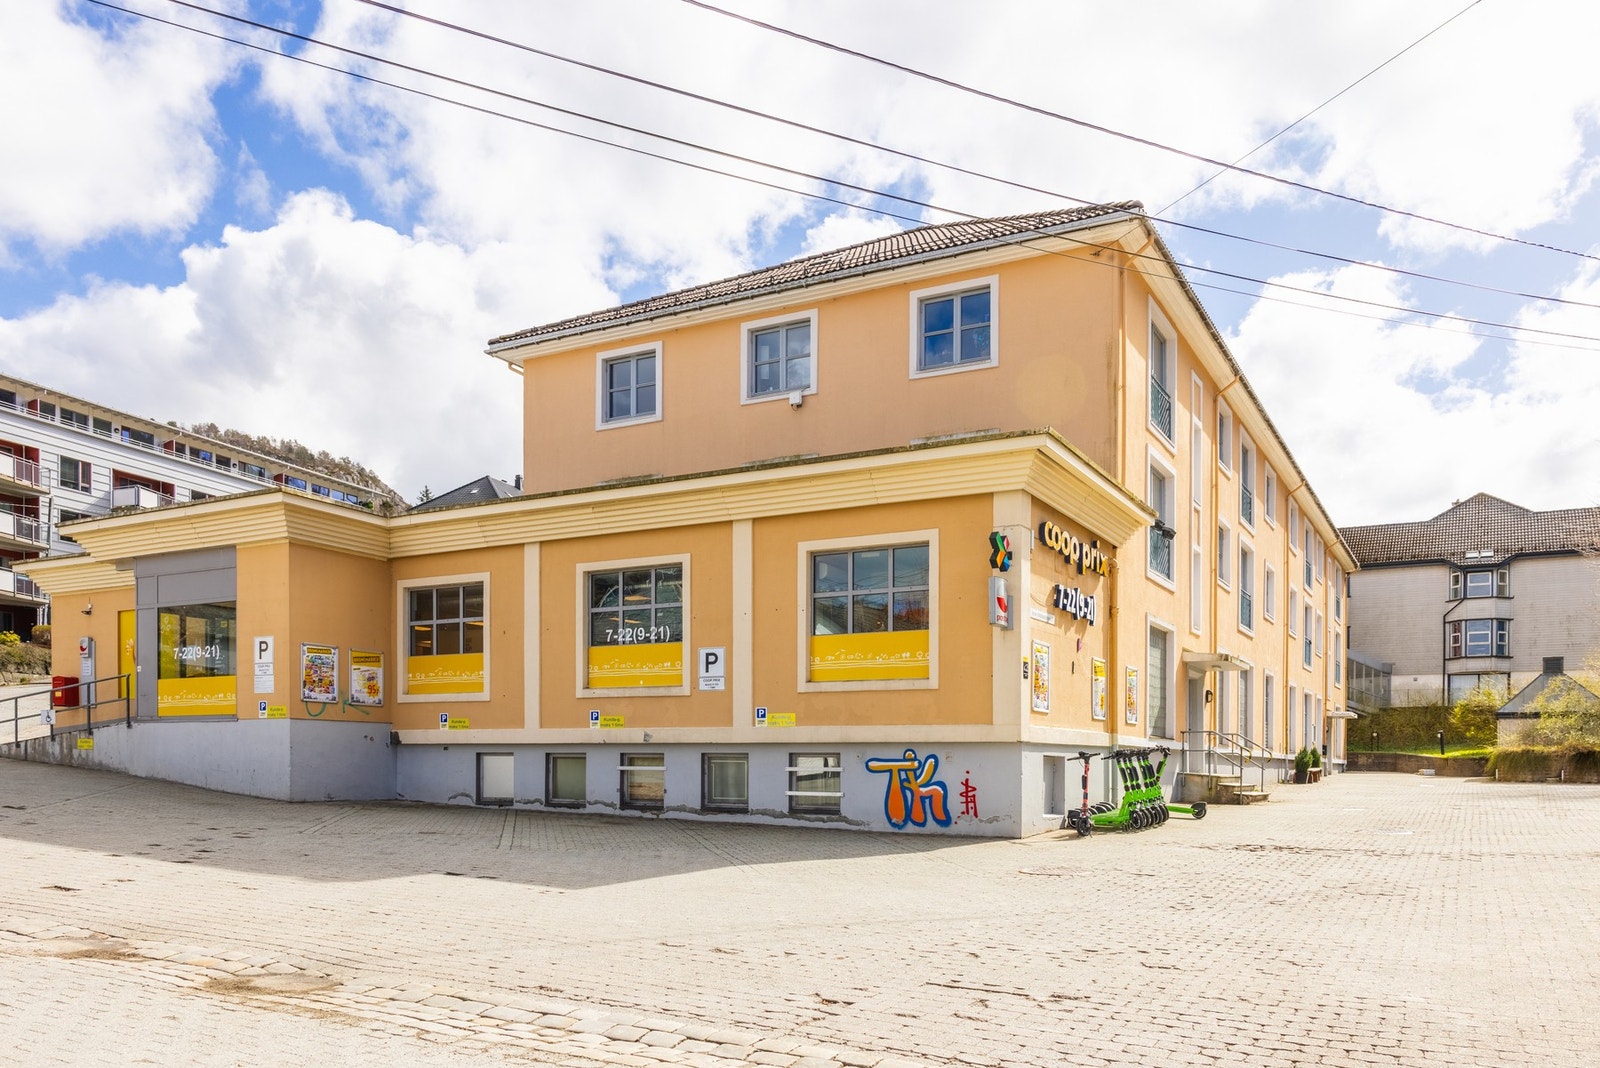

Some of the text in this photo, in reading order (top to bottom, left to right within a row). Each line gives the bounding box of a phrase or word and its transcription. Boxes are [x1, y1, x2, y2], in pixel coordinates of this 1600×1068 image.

[1040, 521, 1108, 577] coop prix
[1056, 584, 1096, 626] 7-22(9-21)
[606, 625, 670, 644] 7-22(9-21)
[173, 645, 220, 661] 7-22(9-21)
[259, 641, 268, 659] P
[705, 653, 718, 673] P
[758, 709, 765, 718] P
